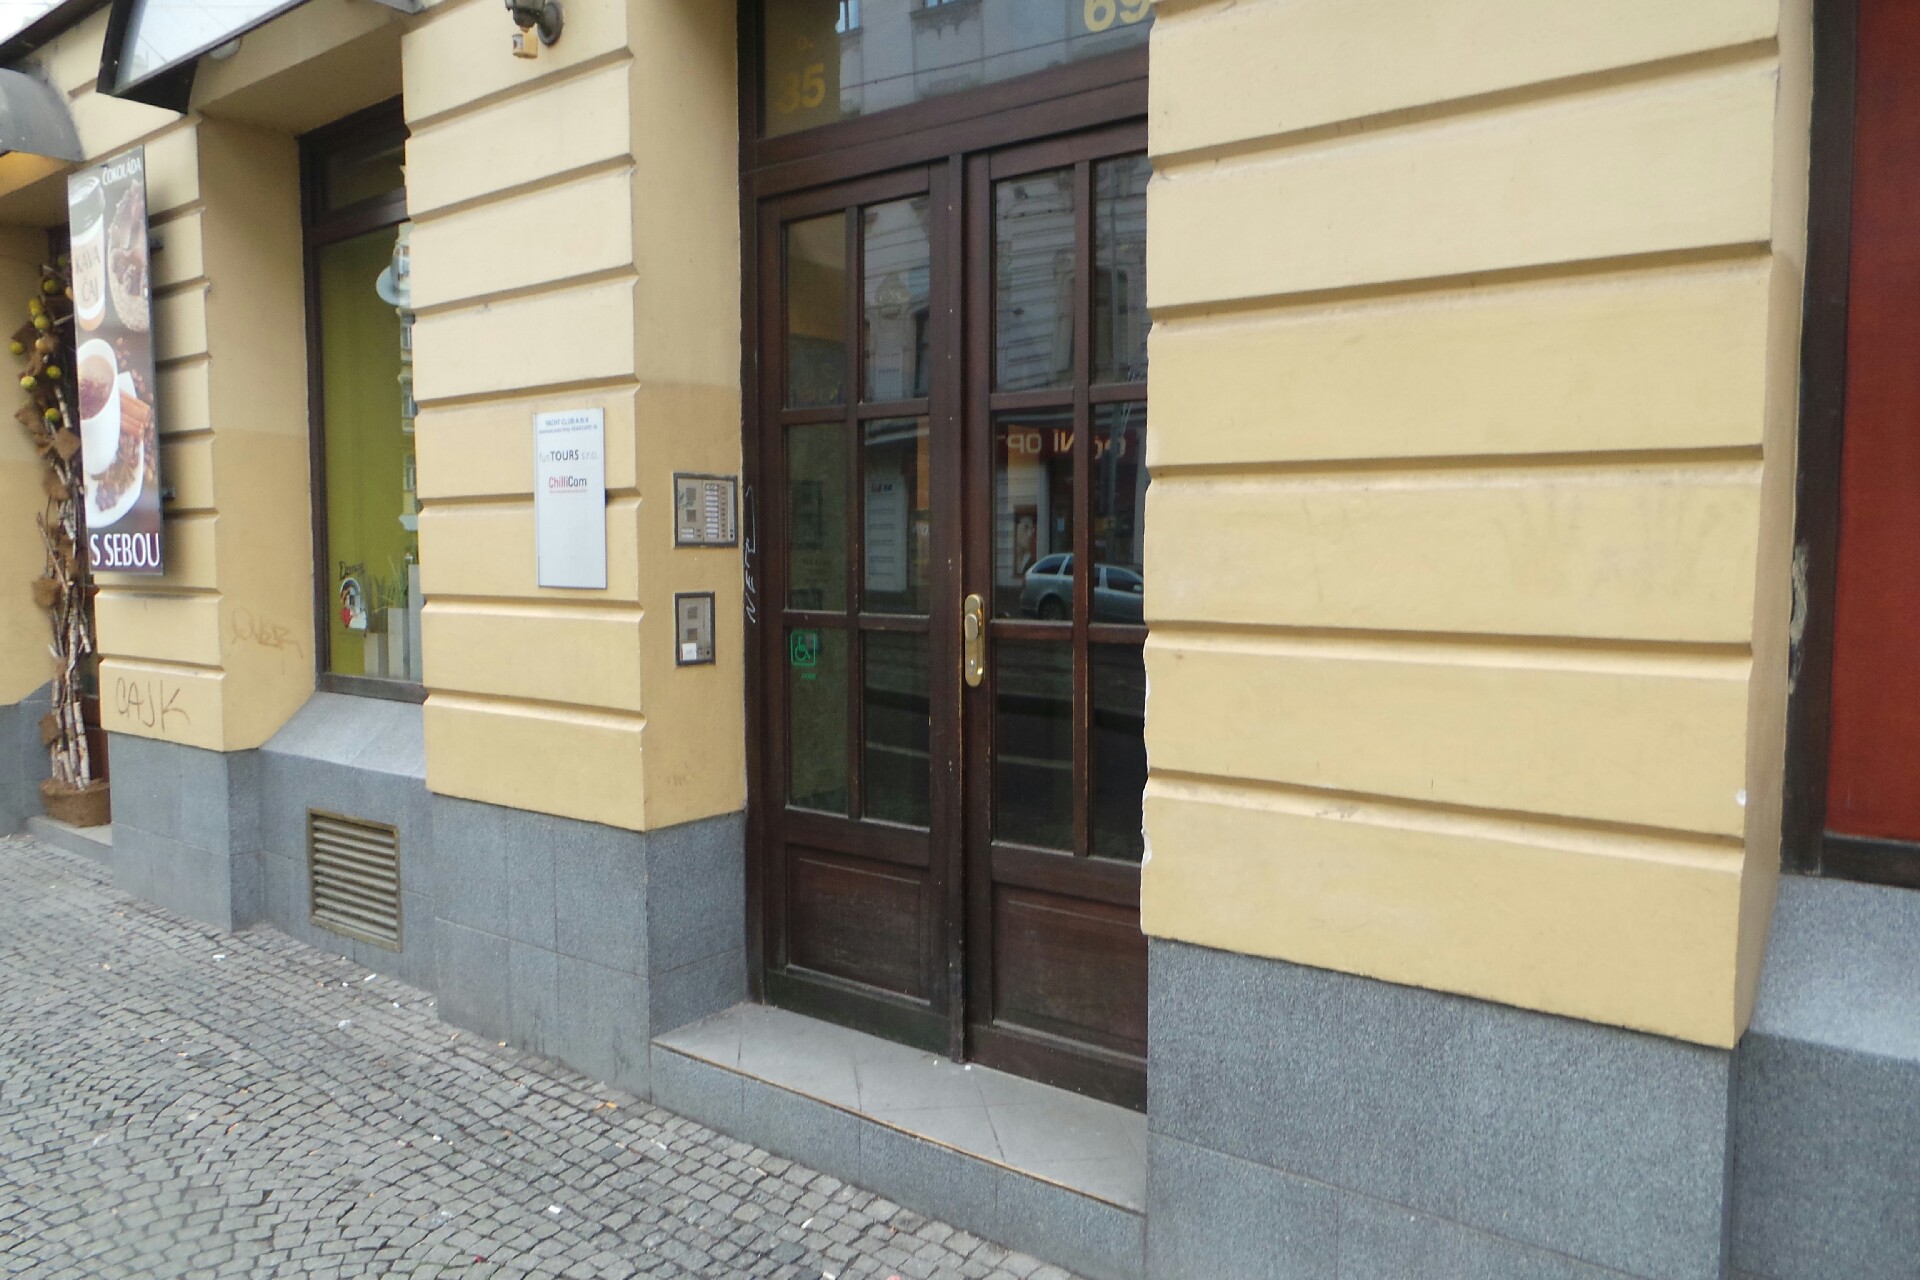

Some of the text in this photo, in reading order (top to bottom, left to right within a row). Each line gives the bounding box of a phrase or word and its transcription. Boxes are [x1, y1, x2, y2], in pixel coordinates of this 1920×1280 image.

[1084, 0, 1151, 33] 69
[102, 157, 142, 186] ČOKOLÁDA
[90, 533, 160, 566] S SEBOU
